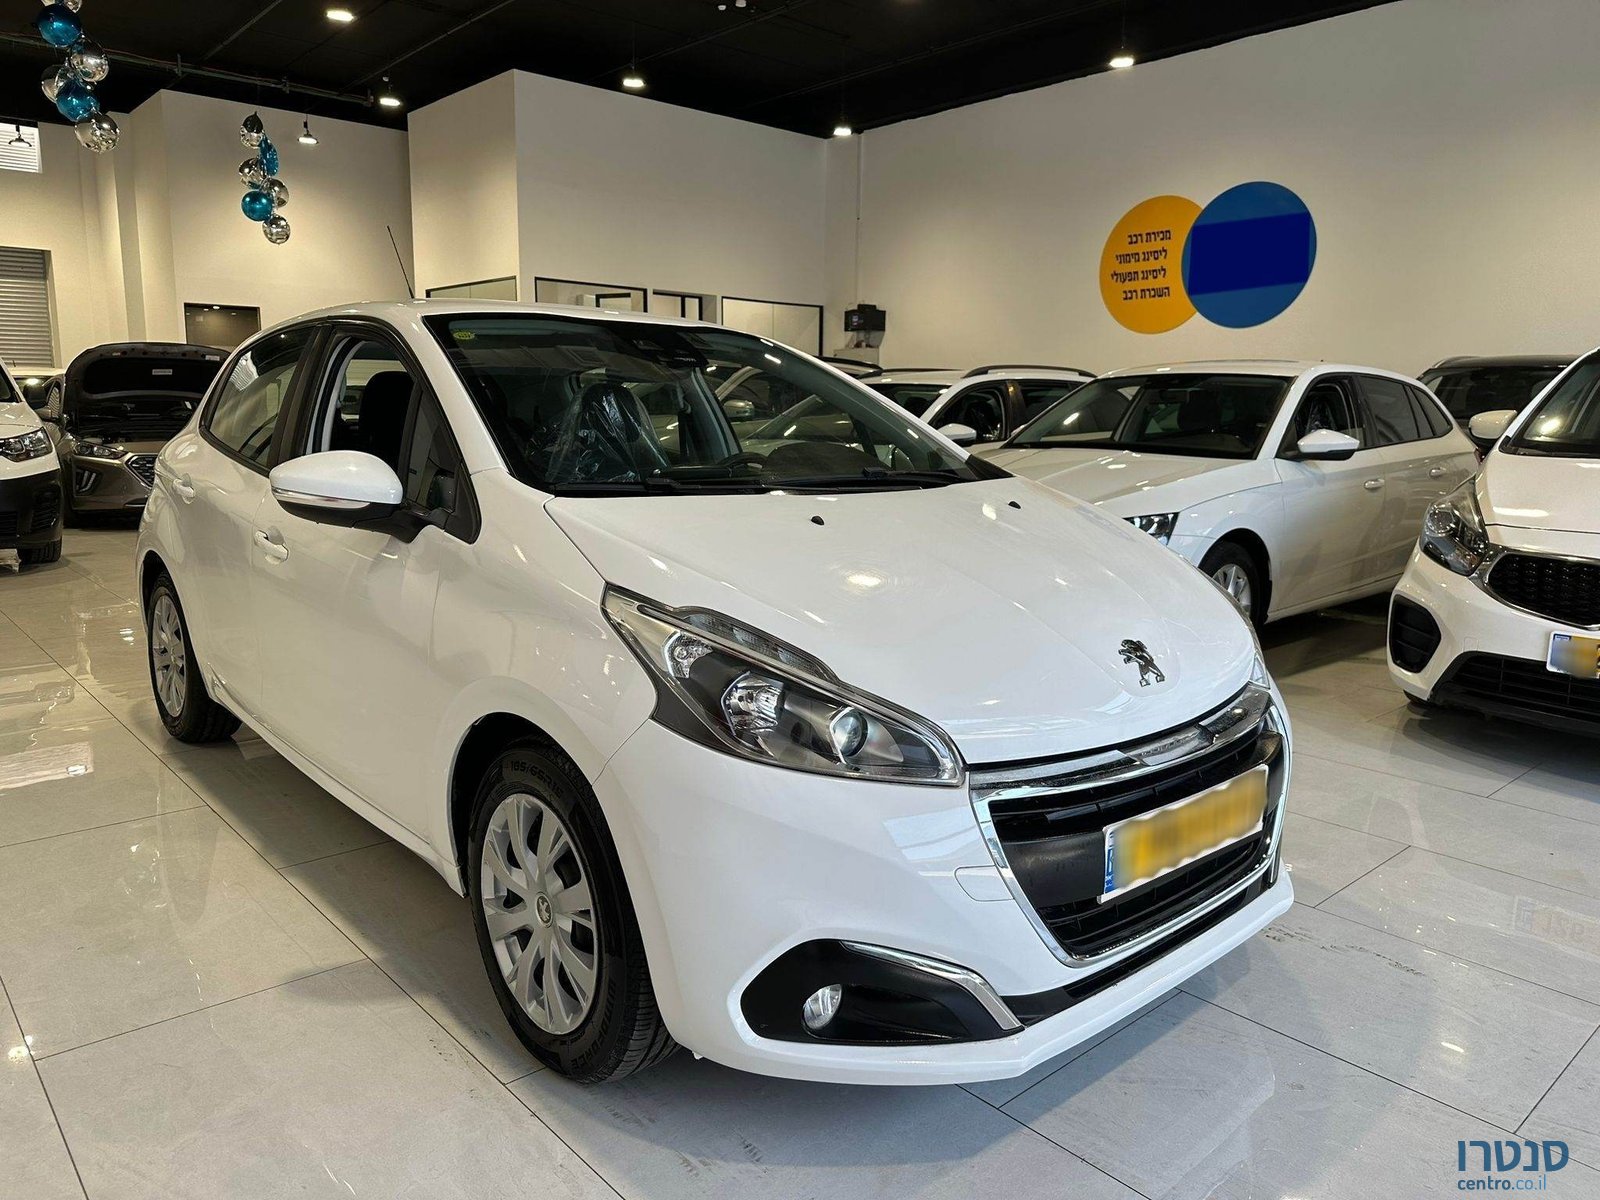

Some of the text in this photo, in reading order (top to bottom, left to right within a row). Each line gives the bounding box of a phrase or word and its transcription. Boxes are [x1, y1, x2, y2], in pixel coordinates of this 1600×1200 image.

[1128, 230, 1171, 245] מכירת רכב
[1116, 246, 1167, 264] ליסינג מימוני
[1111, 266, 1166, 284] ליסינג תפעולי
[1123, 287, 1170, 300] השכרת רכב
